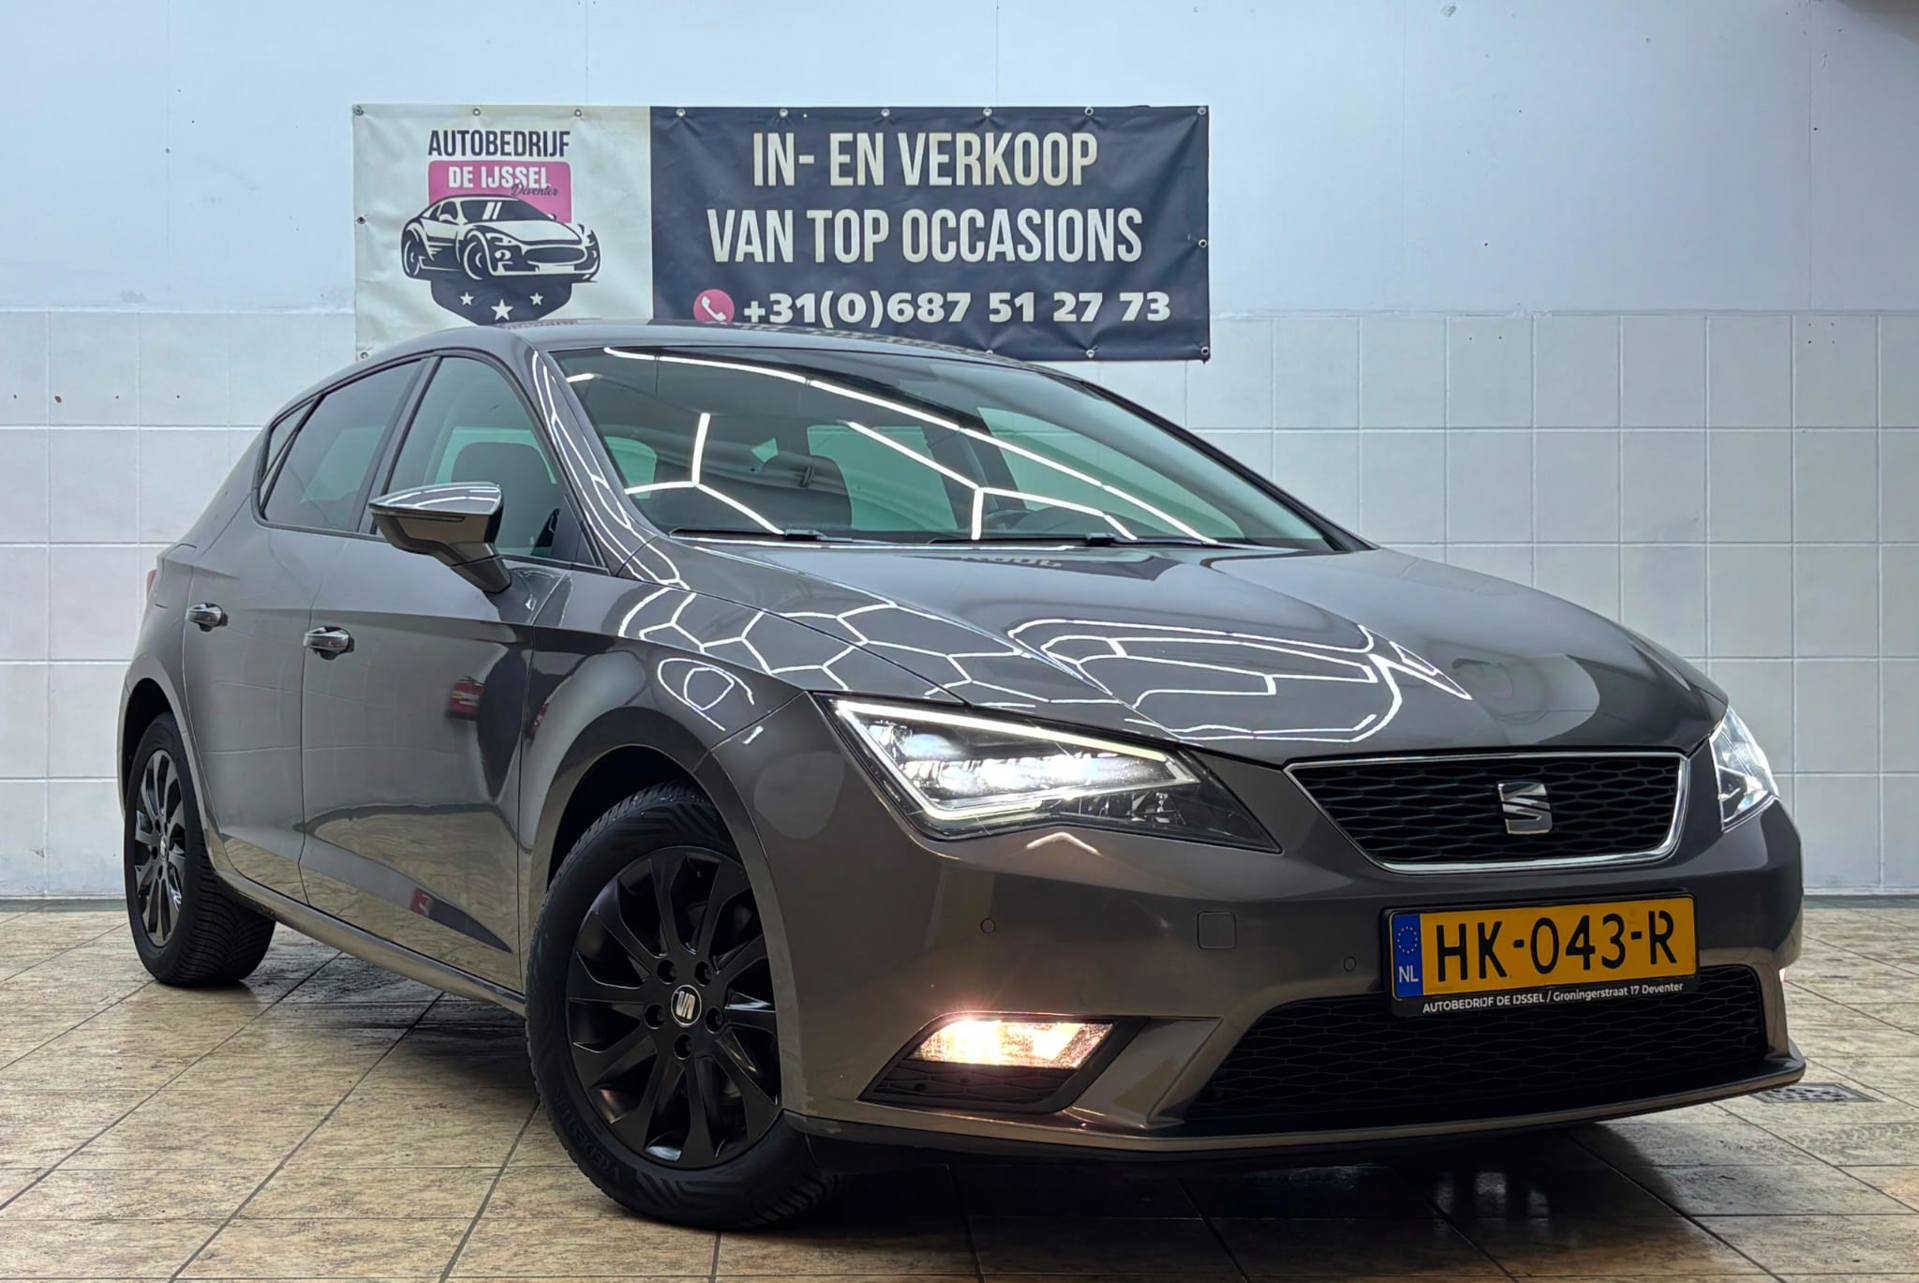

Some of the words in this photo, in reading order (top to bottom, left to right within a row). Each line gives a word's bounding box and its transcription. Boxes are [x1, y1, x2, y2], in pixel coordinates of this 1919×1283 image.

[428, 130, 570, 157] AUTOBEDRIJF
[753, 132, 815, 187] IN-
[830, 132, 885, 187] EN
[897, 132, 1098, 187] VERKOOP
[449, 166, 473, 188] DE
[481, 166, 549, 189] IJSSEL
[706, 209, 794, 263] VAN
[806, 209, 890, 263] TOP
[902, 208, 1143, 263] OCCASIONS
[743, 290, 971, 328] +31(0)687
[989, 292, 1036, 323] 51
[1053, 292, 1103, 322] 27
[1120, 291, 1171, 322] 73
[1436, 910, 1677, 982] HK-043-R
[1399, 965, 1419, 984] NL
[1422, 997, 1494, 1014] AUTOBEDRIJF
[1496, 995, 1511, 1006] DE
[1513, 993, 1545, 1005] IJSSEL
[1553, 987, 1628, 1002] Groningerstraat
[1630, 986, 1639, 996] 17
[1642, 982, 1684, 995] Deventer
